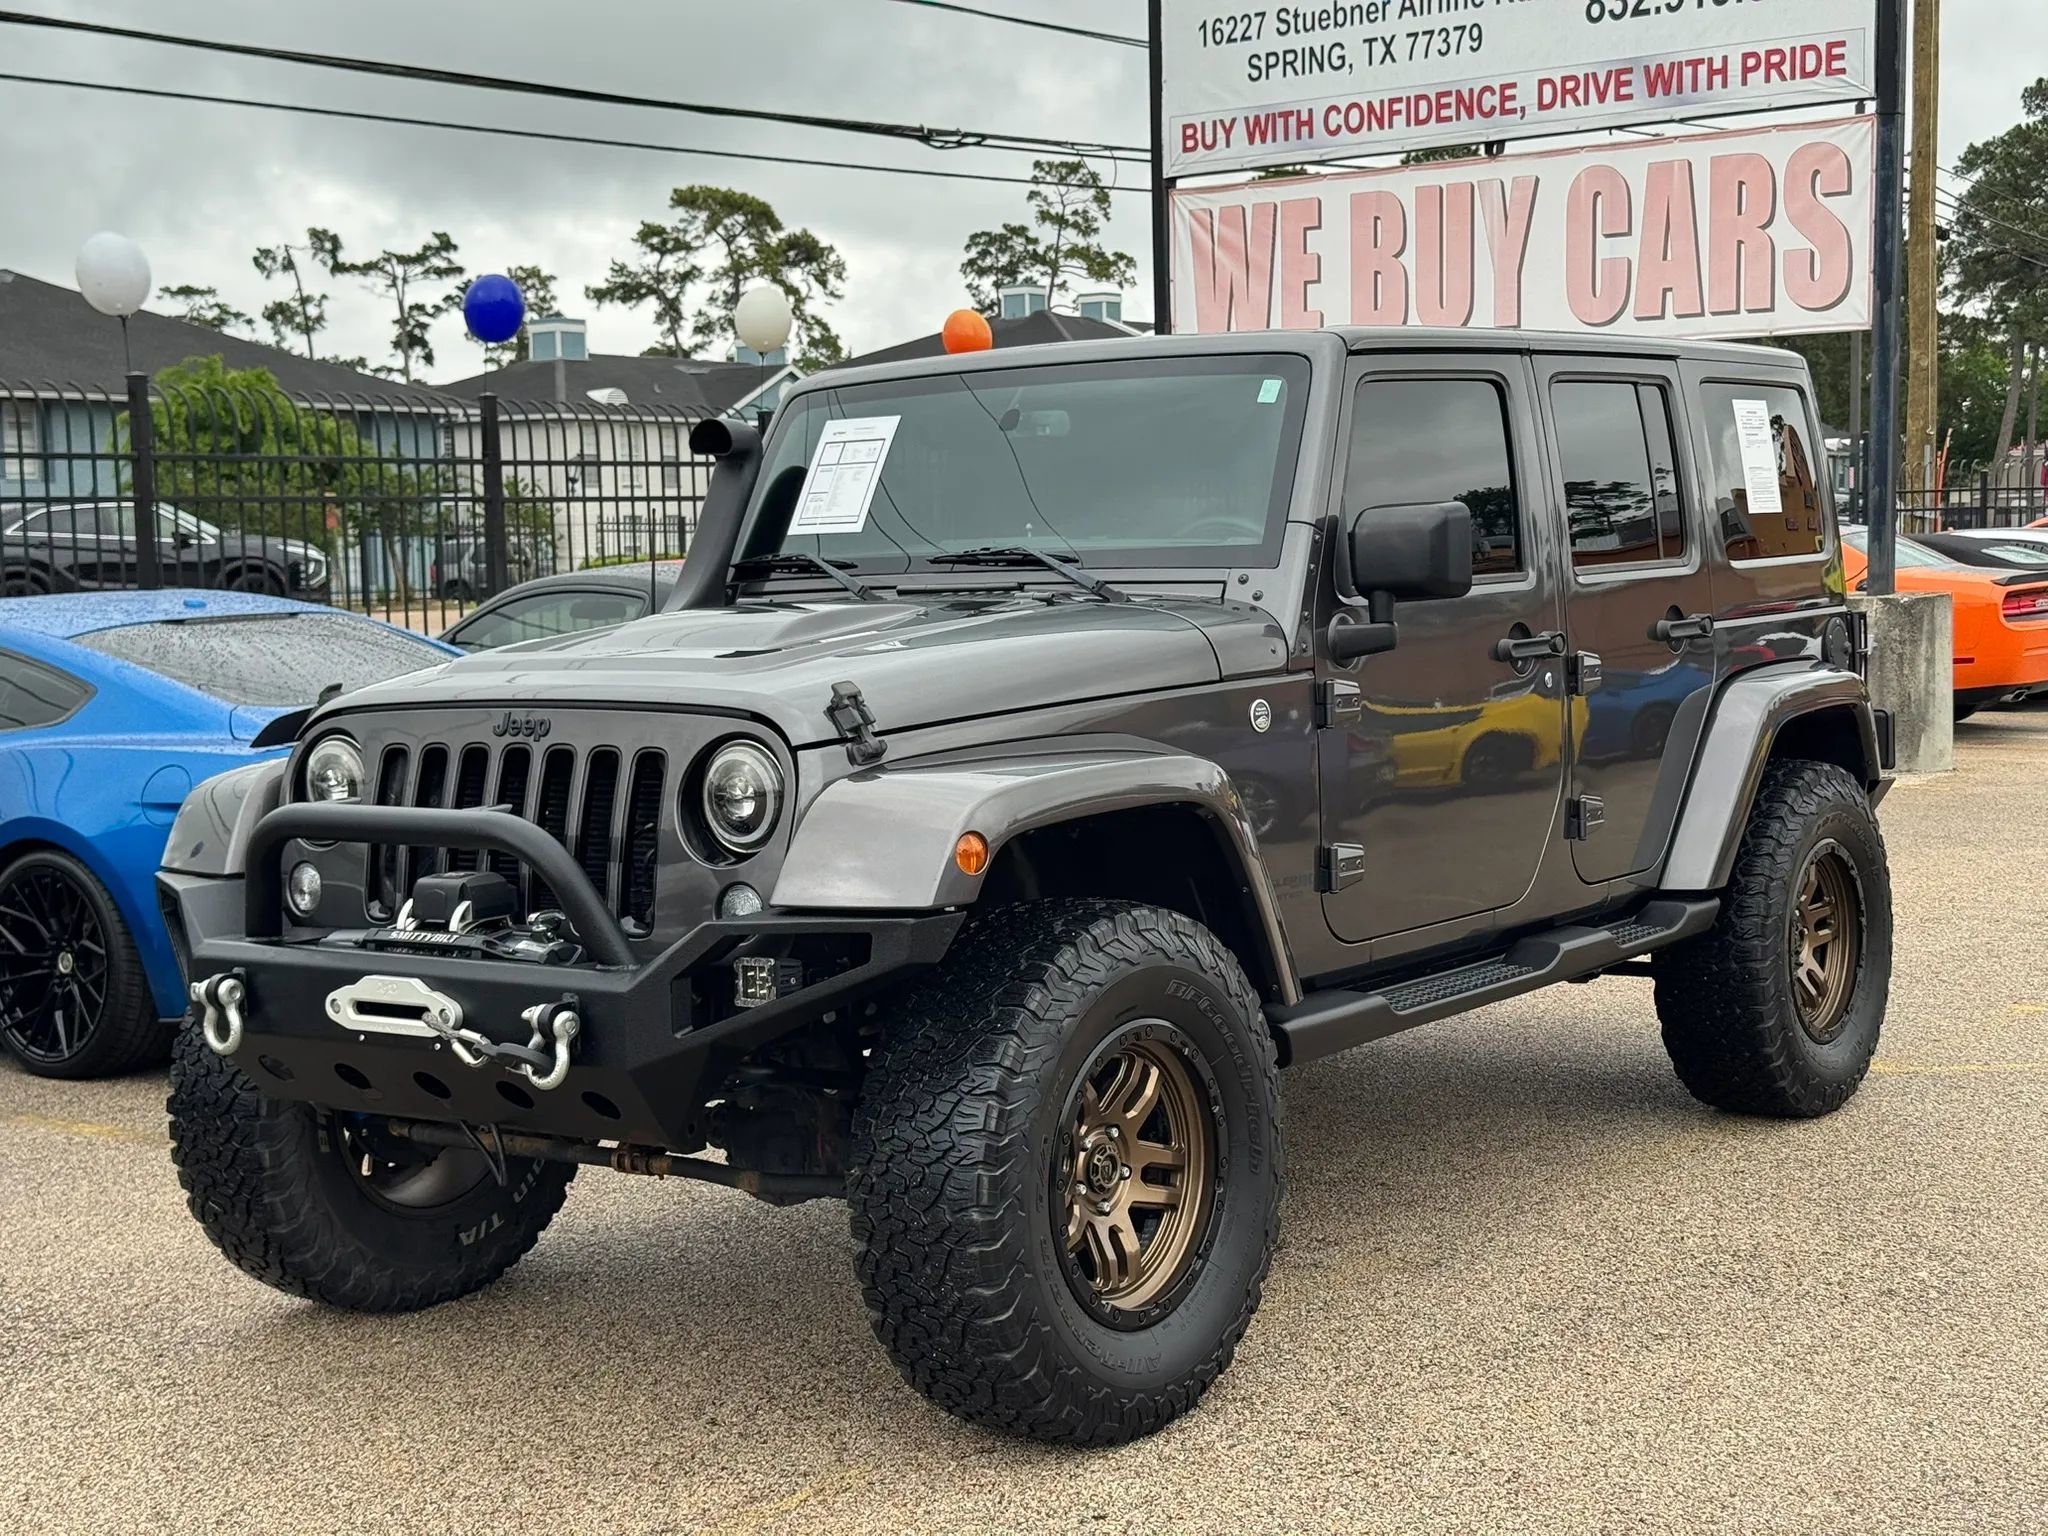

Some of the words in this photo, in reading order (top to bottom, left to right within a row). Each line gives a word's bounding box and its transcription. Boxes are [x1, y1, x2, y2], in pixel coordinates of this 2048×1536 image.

[1198, 12, 1267, 48] 16227
[1276, 0, 1391, 37] Stuebner
[1248, 42, 1354, 82] SPRING,
[1363, 34, 1397, 67] TX
[1406, 23, 1484, 61] 77379
[1181, 116, 1237, 153] BUY
[1244, 108, 1314, 146] WITH
[1323, 82, 1527, 137] CONFIDENCE,
[1537, 67, 1634, 112] DRIVE
[1643, 54, 1728, 98] WITH
[1741, 40, 1847, 87] PRIDE
[1189, 197, 1324, 334] WE
[1350, 175, 1540, 329] BUY
[1566, 141, 1853, 327] CARS
[493, 711, 552, 742] Jeep
[389, 930, 460, 944] SMITTYBILT
